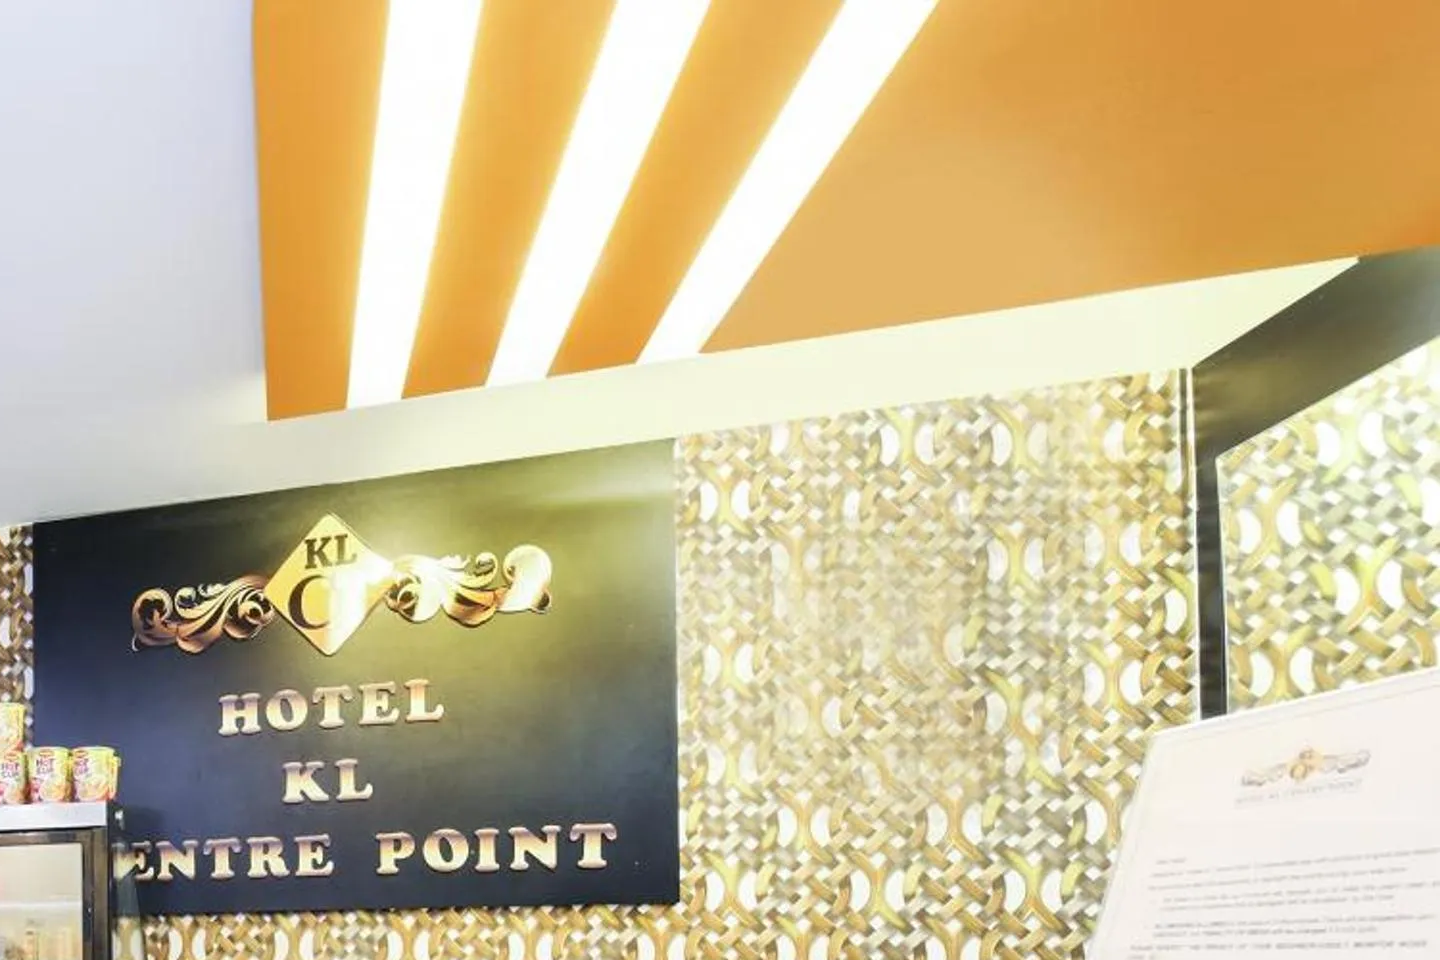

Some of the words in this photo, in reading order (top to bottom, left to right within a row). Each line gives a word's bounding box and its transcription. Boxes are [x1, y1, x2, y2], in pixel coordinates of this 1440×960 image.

[304, 533, 358, 570] KL
[217, 678, 445, 738] HOTEL
[282, 757, 374, 804] KL
[120, 834, 335, 882] ENTRE
[375, 823, 618, 877] POINT
